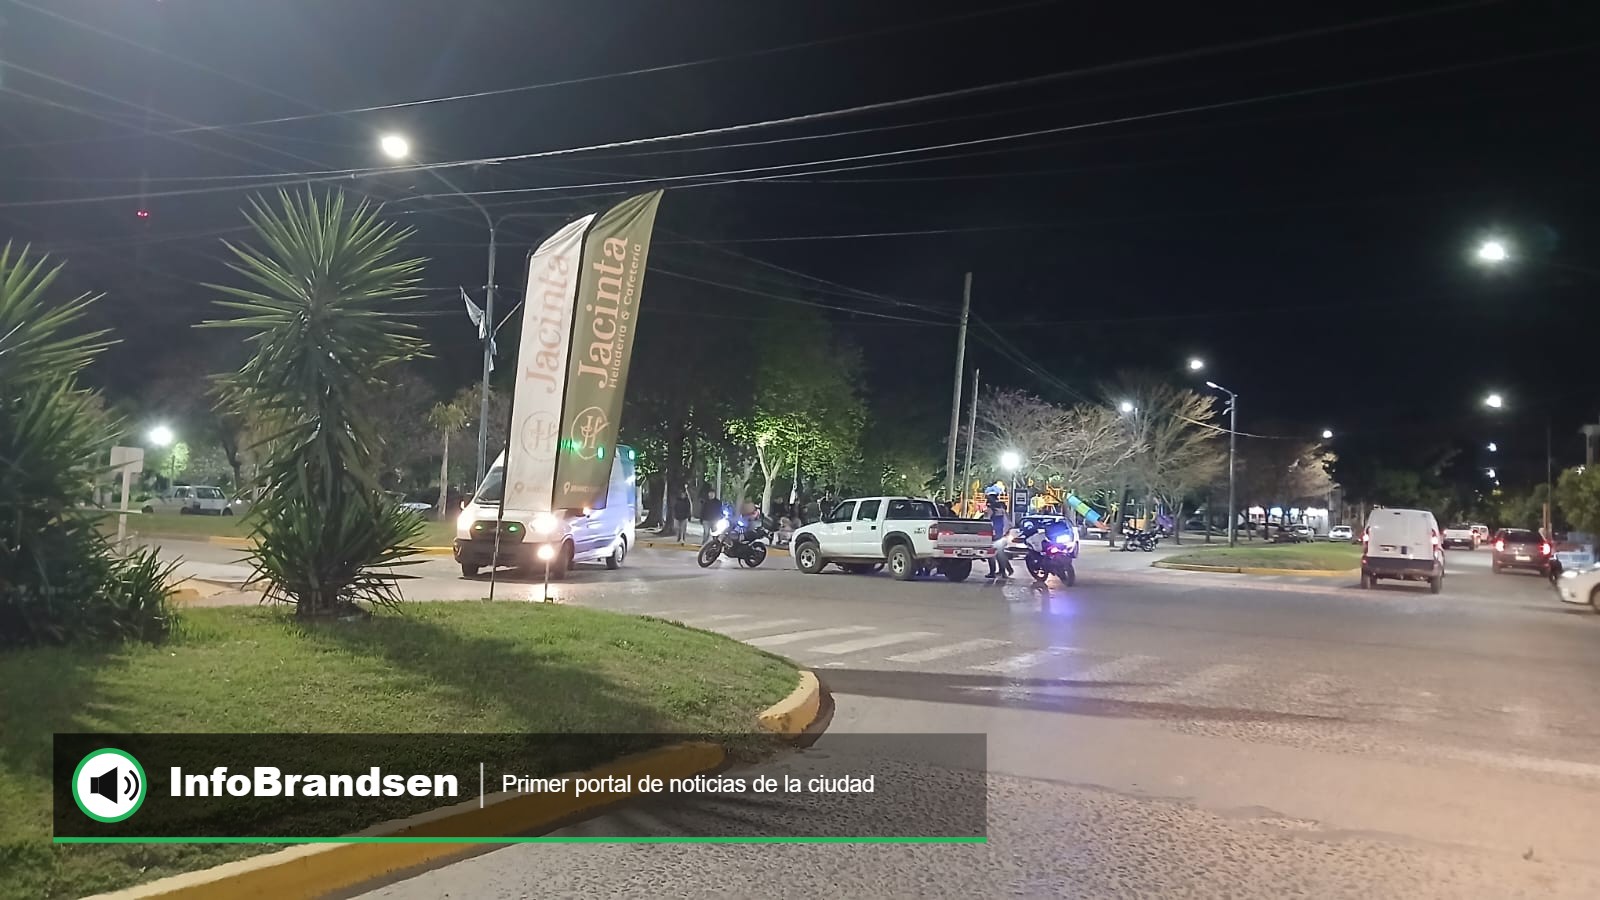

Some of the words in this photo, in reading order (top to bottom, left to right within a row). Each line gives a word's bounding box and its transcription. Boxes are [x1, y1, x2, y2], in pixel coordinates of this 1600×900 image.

[525, 255, 569, 394] Jacinta
[577, 236, 628, 389] Jacinta
[621, 311, 631, 320] &
